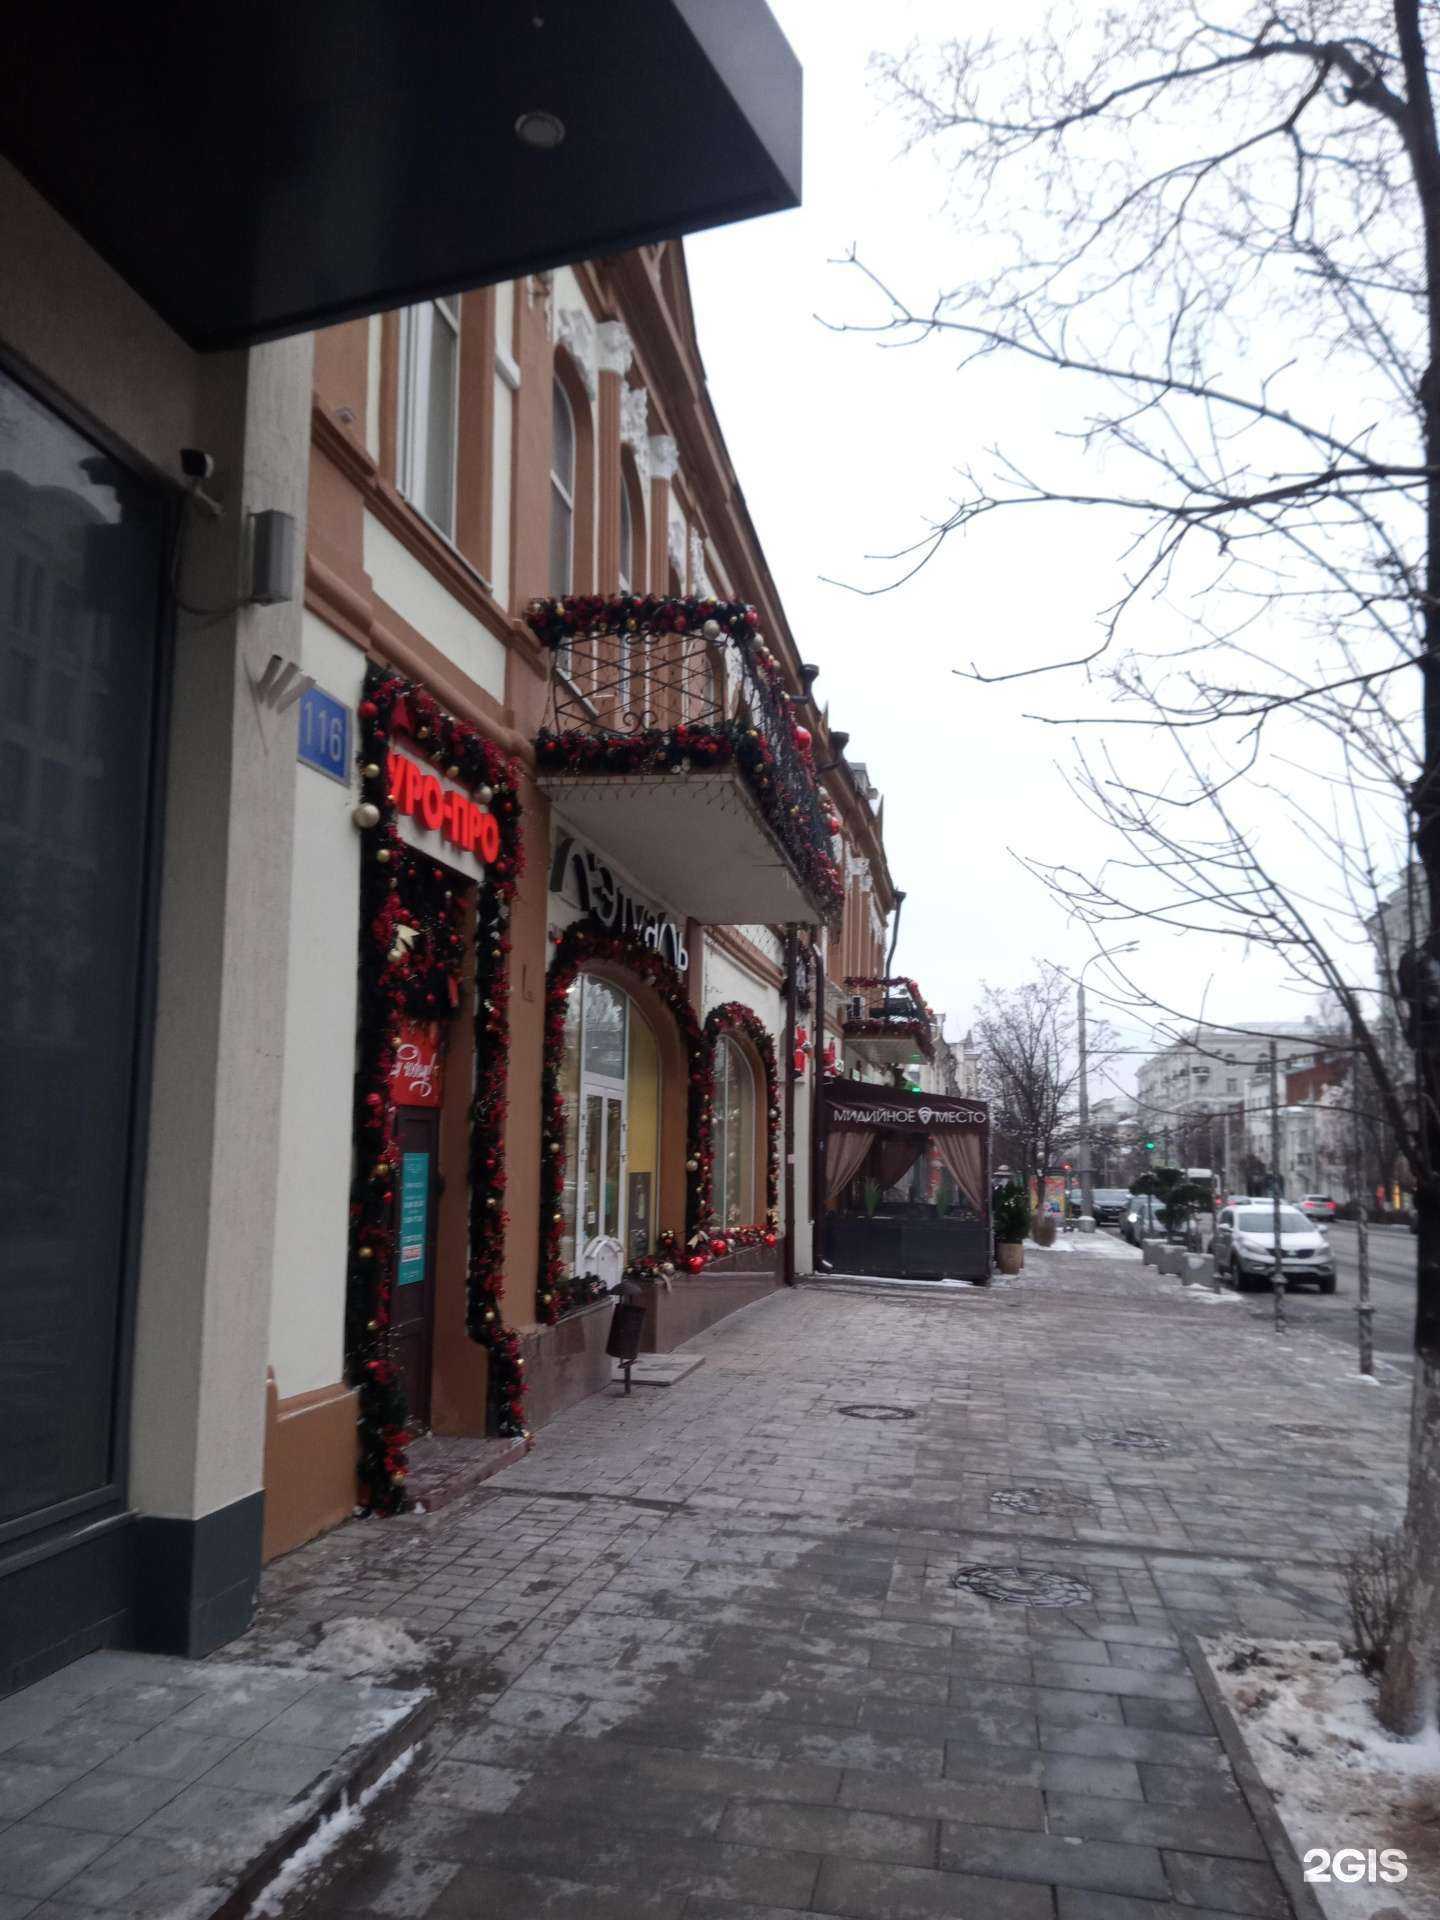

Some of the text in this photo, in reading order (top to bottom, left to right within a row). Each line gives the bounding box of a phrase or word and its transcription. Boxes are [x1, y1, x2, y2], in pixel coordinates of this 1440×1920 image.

[303, 701, 342, 762] 116
[833, 1107, 987, 1124] МИДИЙНОЕ МЕСТО
